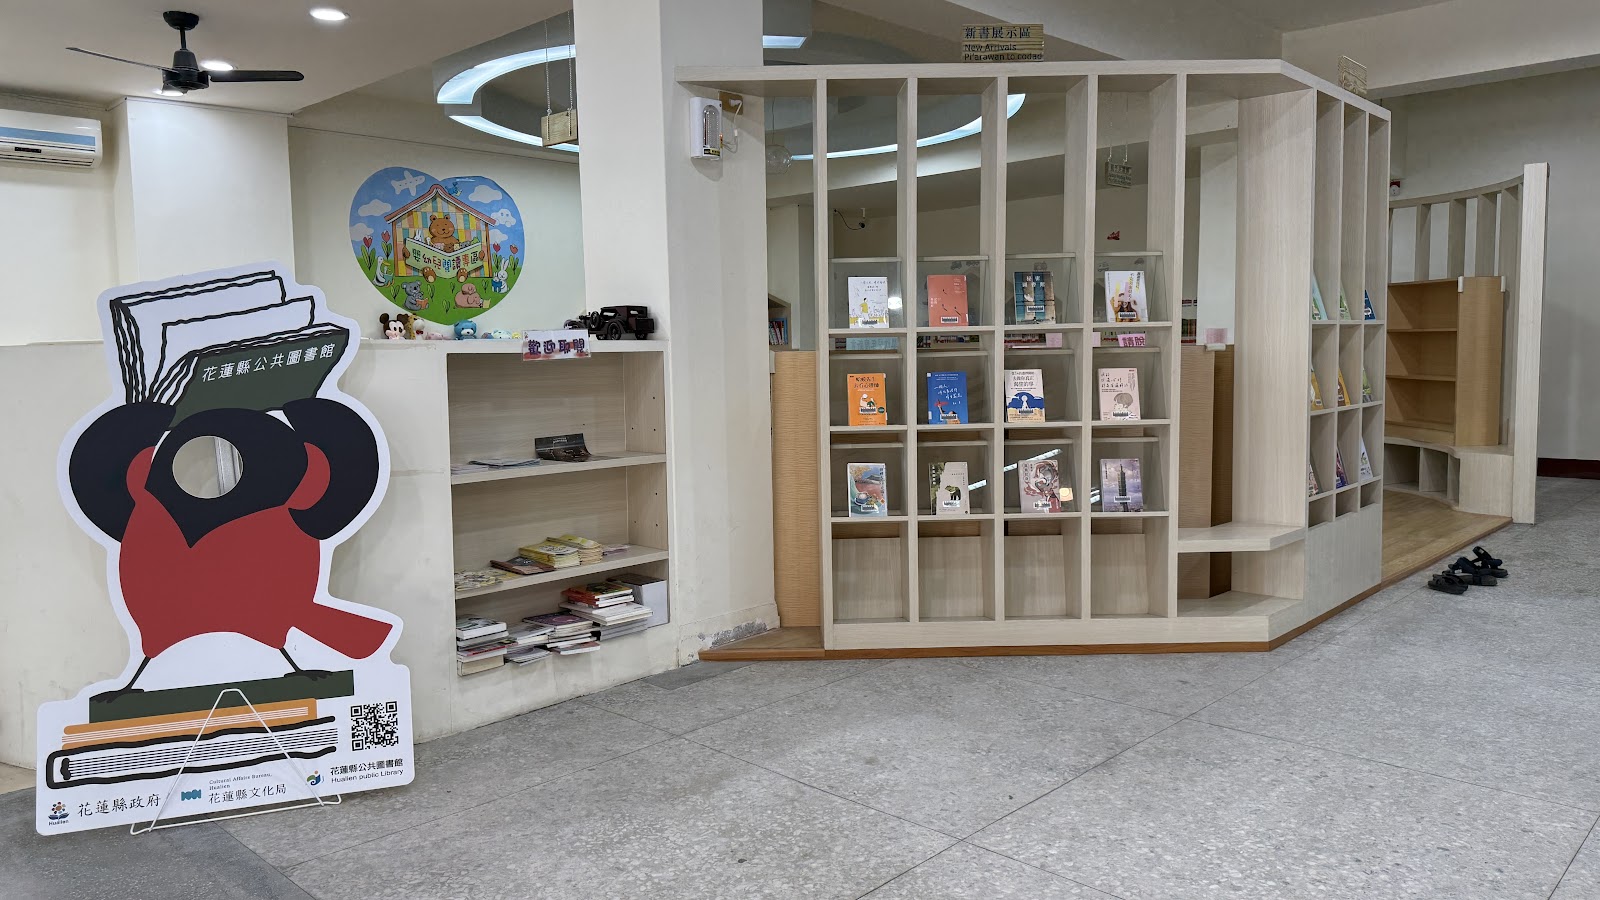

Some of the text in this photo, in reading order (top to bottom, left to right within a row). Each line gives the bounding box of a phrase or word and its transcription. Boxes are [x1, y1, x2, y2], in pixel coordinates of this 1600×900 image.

[964, 26, 1031, 39] 新書展示區
[964, 43, 1017, 52] New Arrivals
[527, 338, 585, 355] 歡迎取閱
[202, 343, 335, 382] 花蓮縣公共圖書館
[330, 758, 404, 776] 花蓮縣公共圖書館
[359, 772, 379, 780] public
[381, 769, 404, 777] Library
[208, 783, 287, 805] 花蓮縣文化局
[77, 793, 161, 818] 花蓮縣政府
